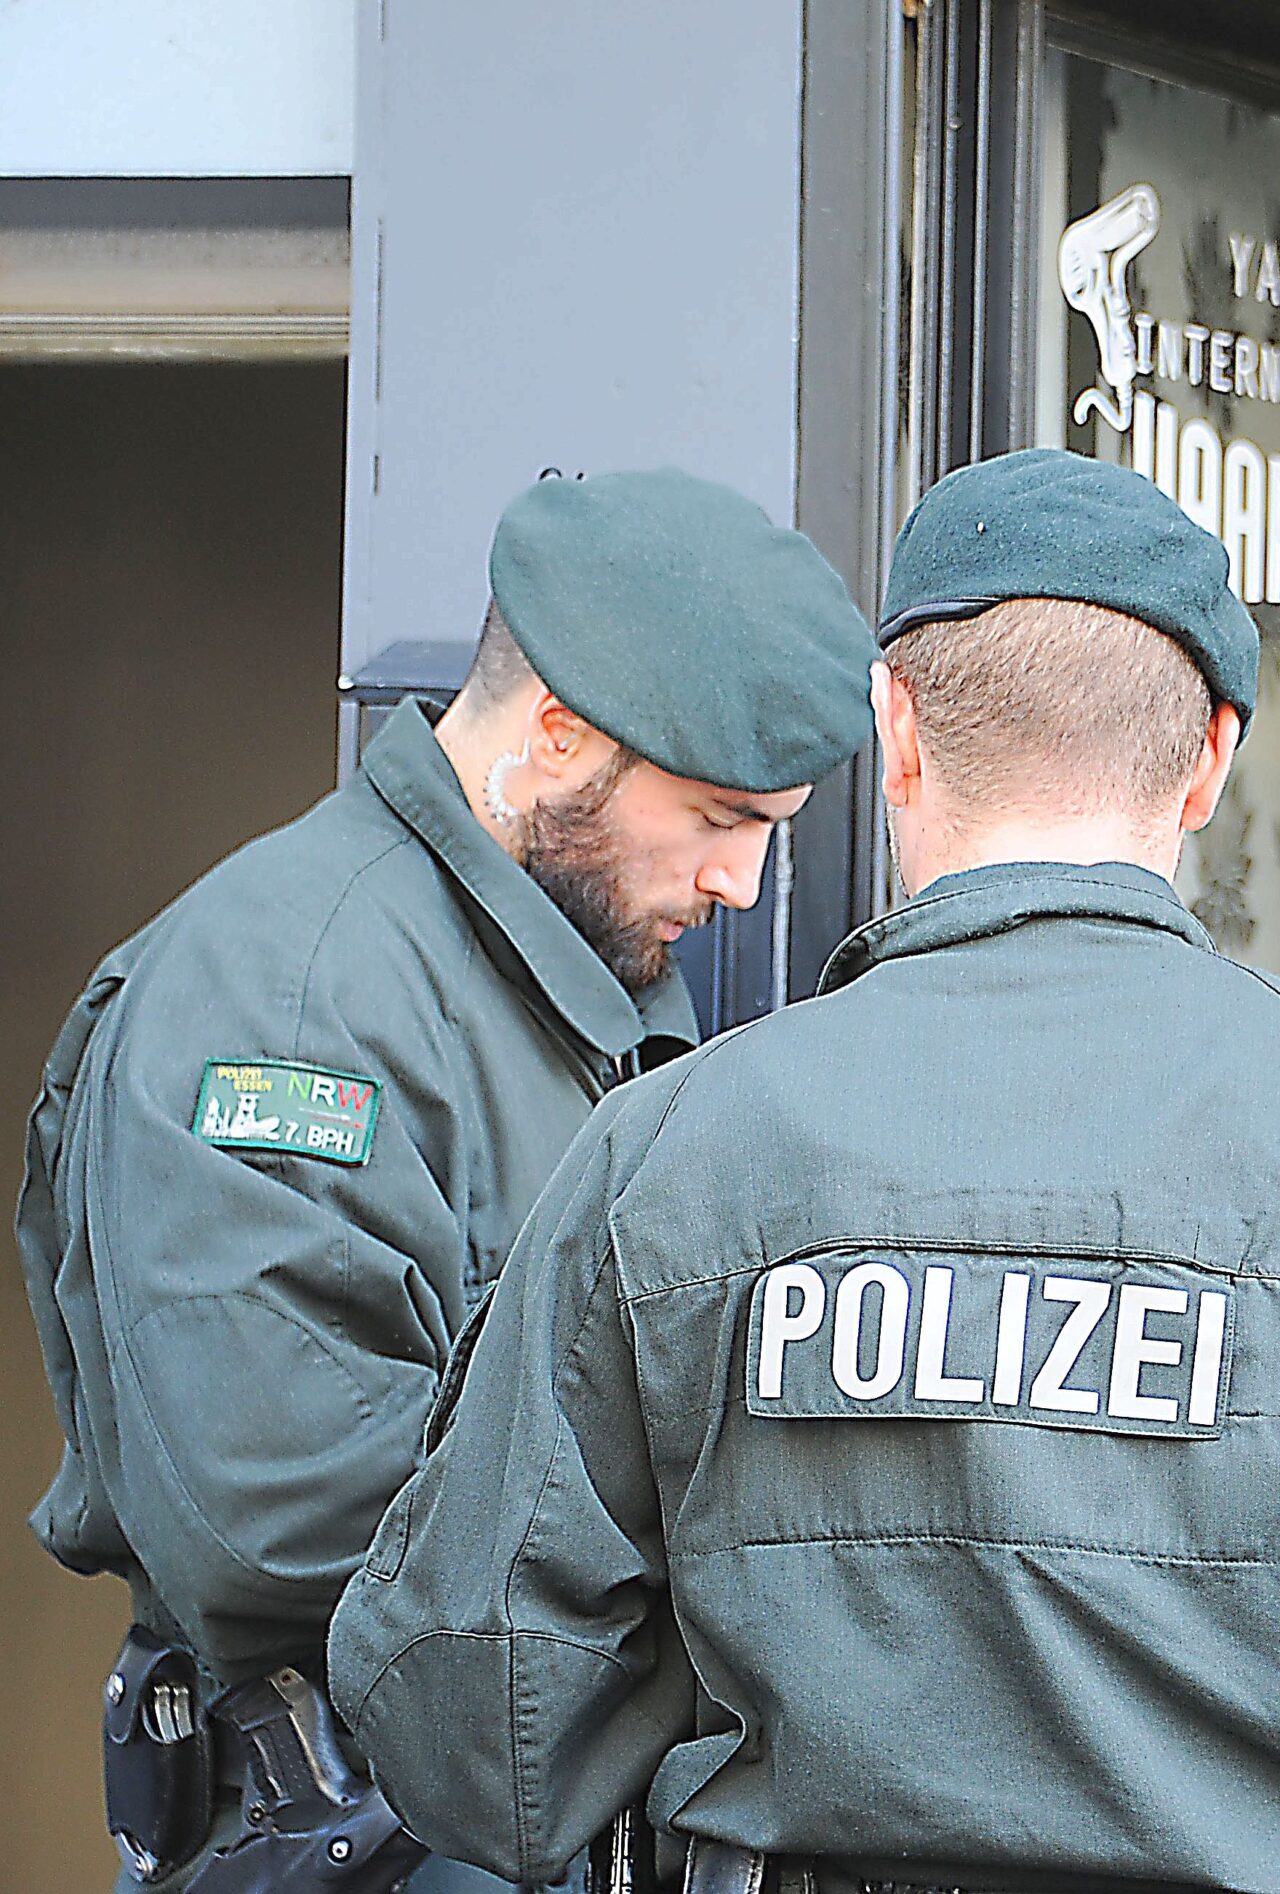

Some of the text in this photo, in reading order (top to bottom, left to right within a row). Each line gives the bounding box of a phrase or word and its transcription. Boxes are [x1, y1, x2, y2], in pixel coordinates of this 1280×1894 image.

[287, 1071, 373, 1112] NRW
[285, 1121, 355, 1155] 7. BPH
[758, 1262, 1227, 1426] POLIZEI
